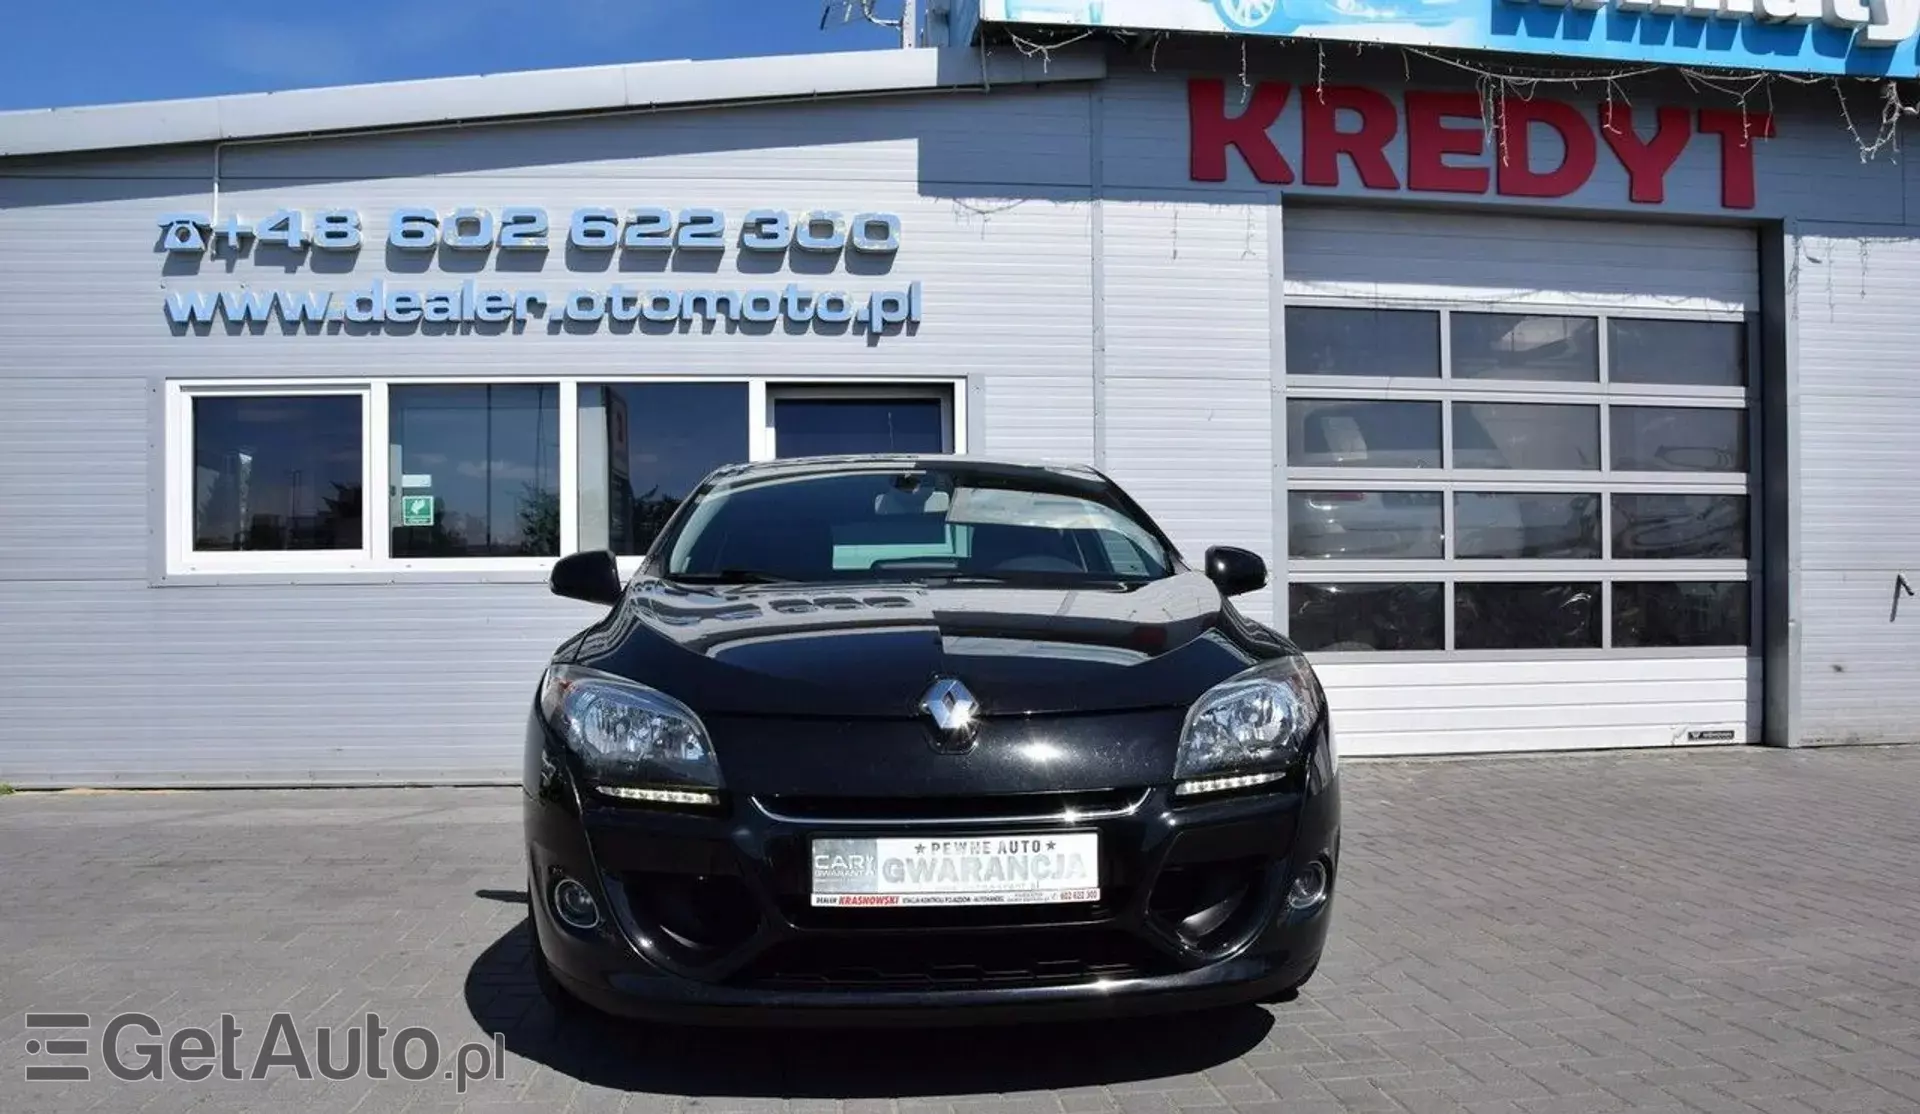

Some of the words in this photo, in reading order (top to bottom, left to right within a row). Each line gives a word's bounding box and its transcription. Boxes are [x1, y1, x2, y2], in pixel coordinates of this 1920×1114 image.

[1187, 78, 1776, 210] KREDYT
[213, 207, 363, 251] +48
[389, 206, 550, 250] 602
[570, 206, 727, 250] 622
[742, 208, 903, 254] 300
[164, 278, 922, 334] www.dealer.otomoto.pl
[814, 854, 864, 870] CAR
[930, 841, 992, 856] PEWNE
[997, 839, 1042, 855] AUTO
[881, 852, 1089, 884] GWARANCJA
